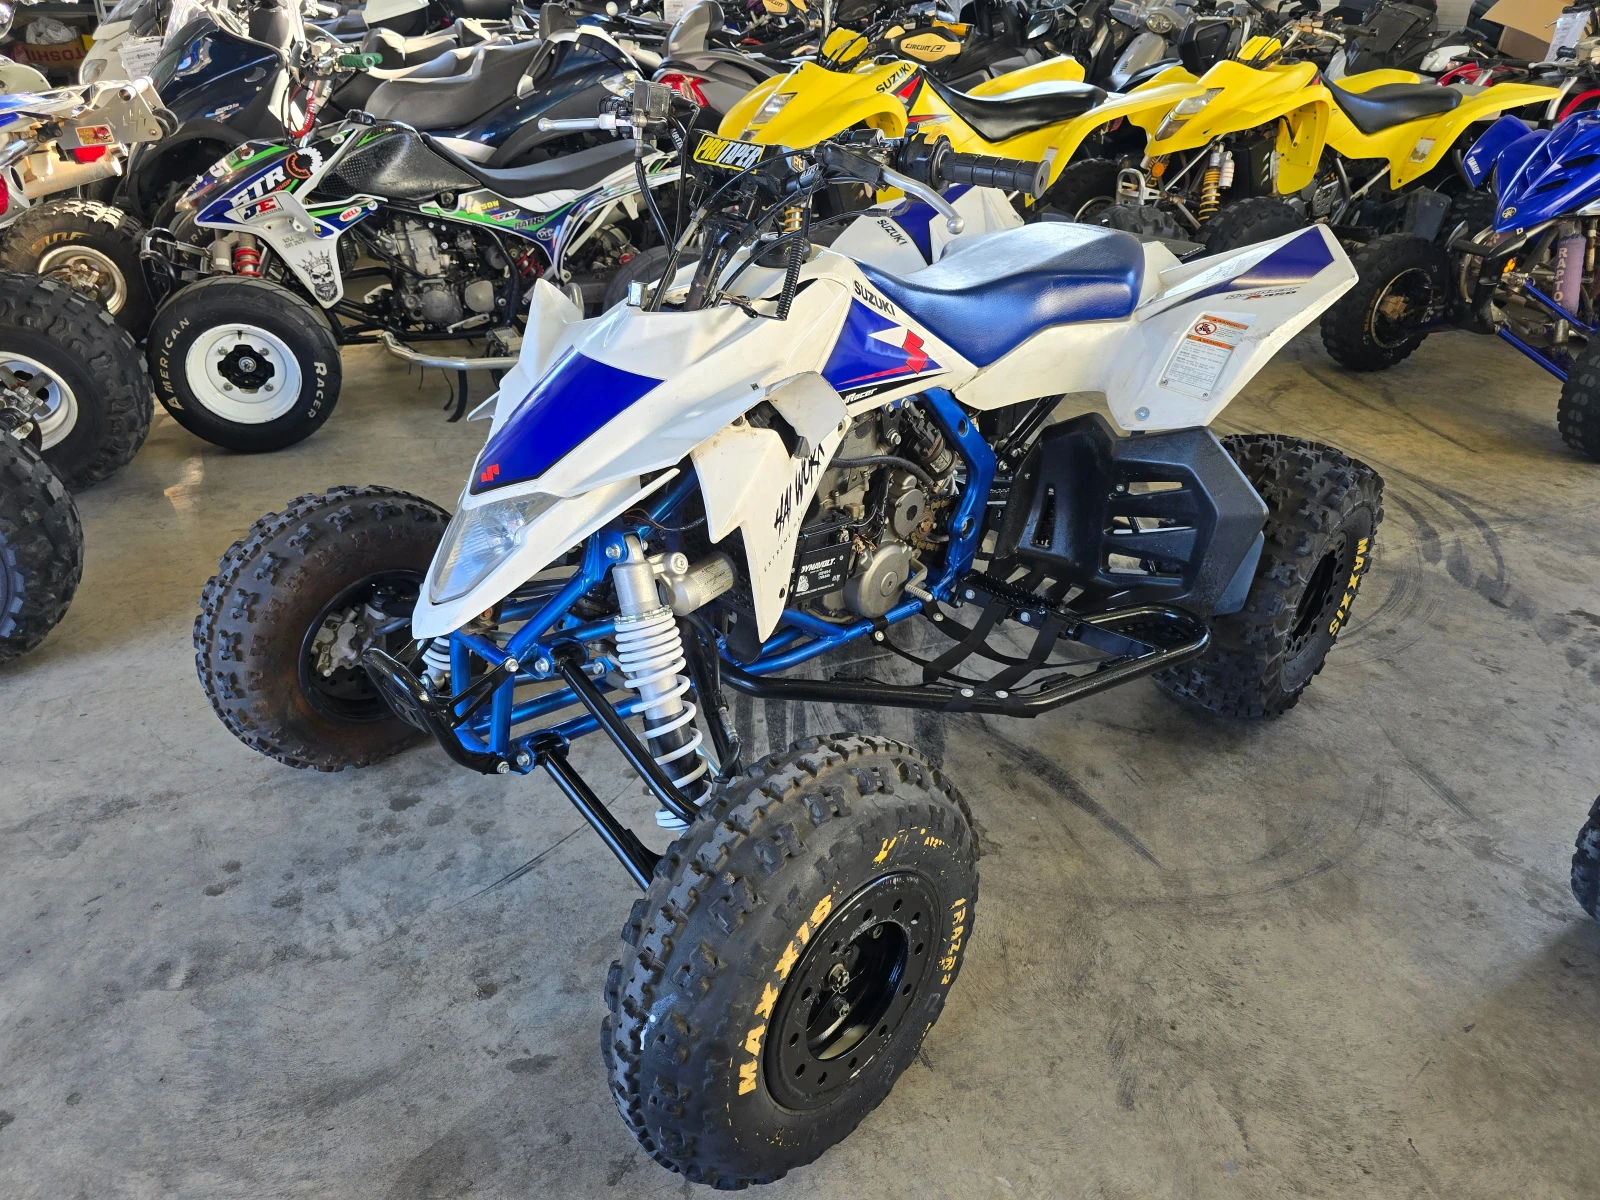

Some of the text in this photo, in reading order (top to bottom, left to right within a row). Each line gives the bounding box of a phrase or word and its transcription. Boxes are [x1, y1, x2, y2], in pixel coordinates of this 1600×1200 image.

[905, 43, 931, 51] CIRCUIT
[876, 62, 912, 93] SUZUKI
[698, 136, 763, 170] PROTAPER
[1466, 156, 1481, 176] YAMAHA
[243, 197, 276, 220] JE
[341, 208, 360, 220] BELL
[498, 210, 519, 220] FLY
[877, 219, 908, 245] SUZUKI
[1553, 247, 1568, 306] RAPTO
[854, 280, 896, 317] SUZUKI
[159, 317, 190, 411] AMERICAN
[307, 361, 328, 419] RACER
[1329, 537, 1369, 637] MAXXIS
[738, 894, 832, 1096] MAXXIS
